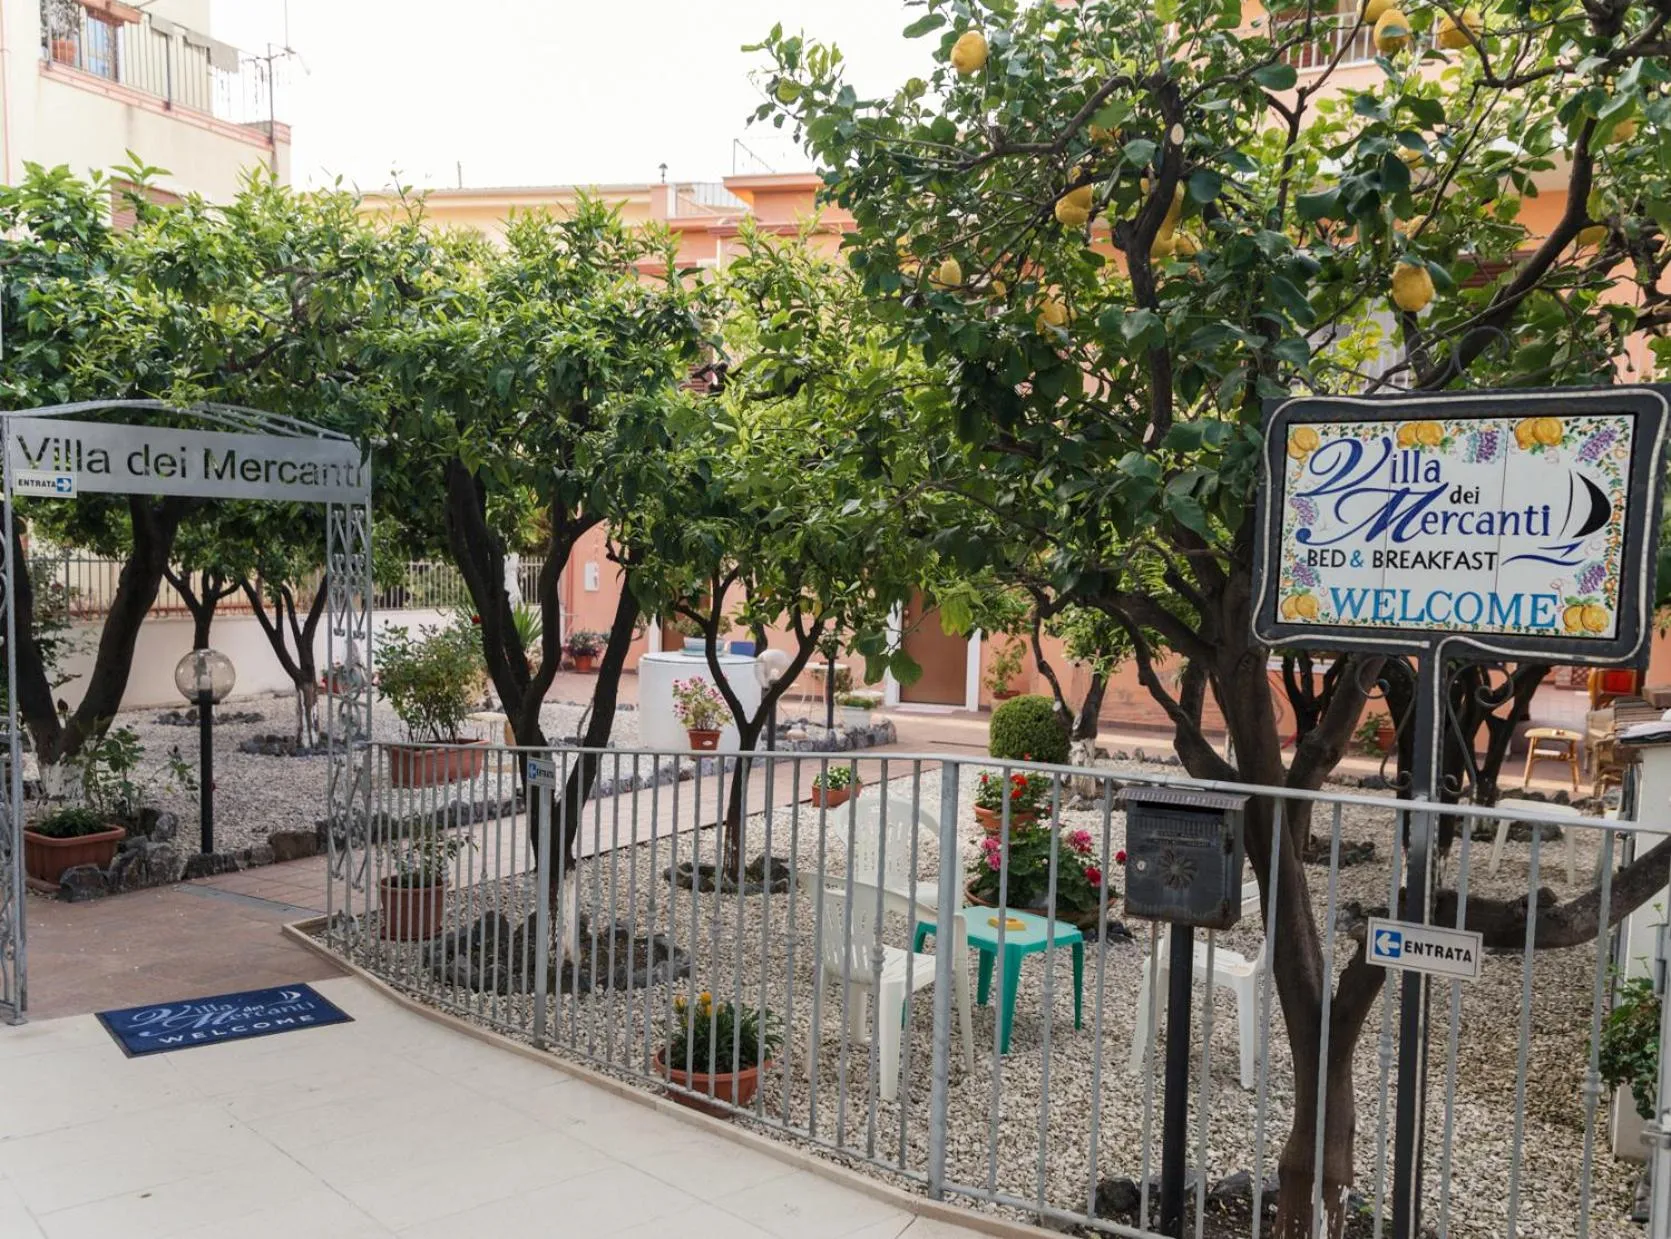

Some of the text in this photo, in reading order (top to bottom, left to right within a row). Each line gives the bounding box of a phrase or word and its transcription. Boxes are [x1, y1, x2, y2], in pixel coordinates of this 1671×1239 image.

[16, 434, 363, 489] Villa dei Mercanti
[1295, 436, 1441, 497] Villa
[18, 478, 57, 488] ENTRATA
[1449, 484, 1480, 505] dei
[1296, 482, 1551, 544] Mercanti
[1306, 547, 1499, 572] BED & BREAKFAST
[1328, 586, 1559, 629] WELCOME
[1404, 940, 1473, 962] ENTRATA
[159, 1013, 316, 1044] WELCOME
